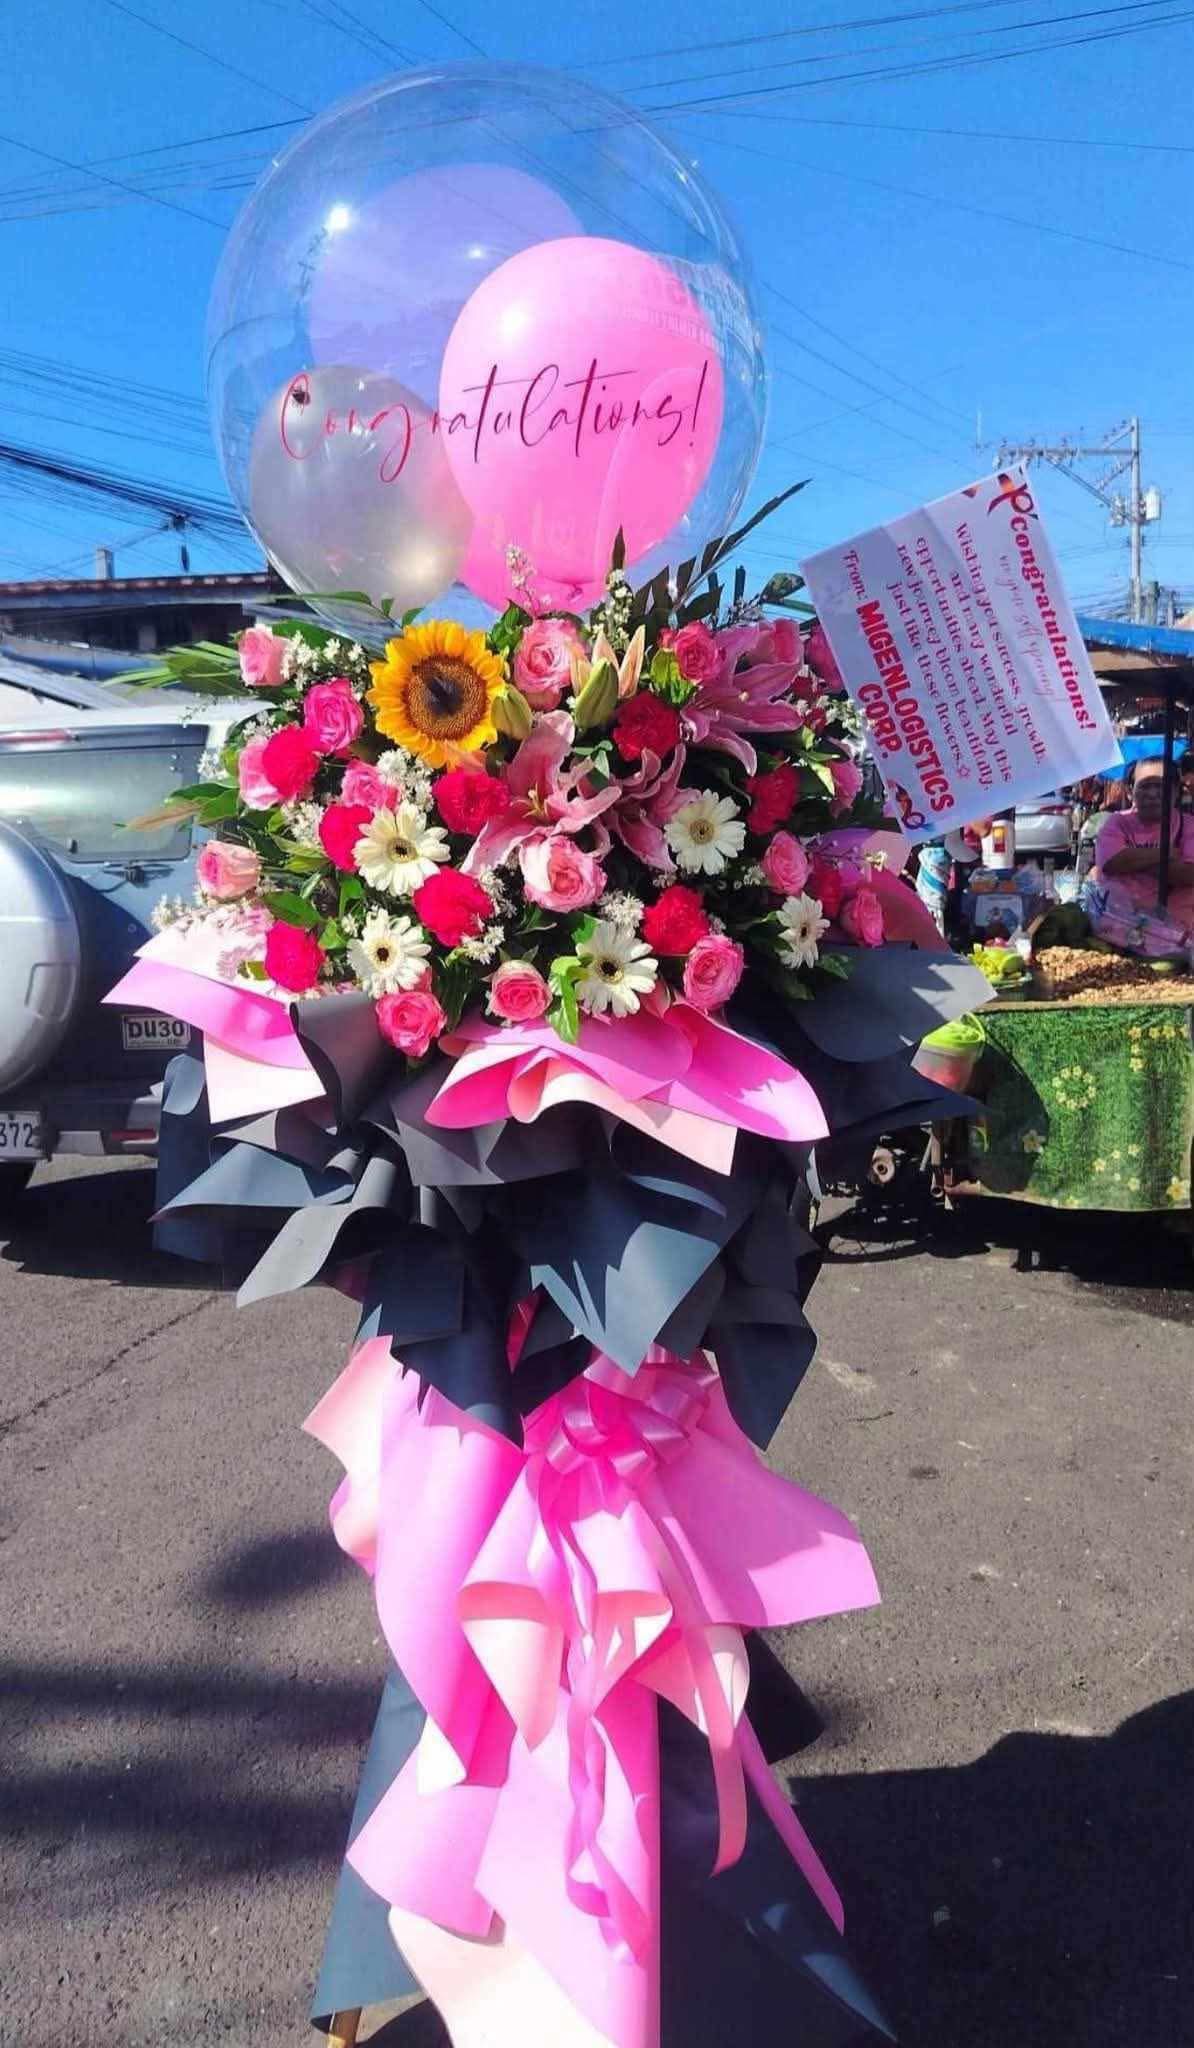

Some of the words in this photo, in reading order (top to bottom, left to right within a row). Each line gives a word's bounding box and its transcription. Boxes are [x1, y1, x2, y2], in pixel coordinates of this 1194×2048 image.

[280, 358, 709, 483] Congratulations!
[896, 544, 917, 577] new
[955, 522, 987, 595] Wishing
[886, 579, 912, 617] just
[903, 618, 924, 651] like
[916, 653, 941, 699] these
[906, 579, 942, 645] journey
[1010, 514, 1096, 730] Congratulations!
[914, 536, 965, 653] opportunities
[978, 711, 1001, 746] May
[992, 748, 1013, 782] this
[934, 646, 961, 697] bloom
[979, 652, 1019, 735] wonderful
[857, 600, 954, 812] MIGENLOGISTICS
[857, 681, 903, 759] CORP.
[128, 1020, 184, 1038] DU30
[0, 1122, 33, 1148] 372
